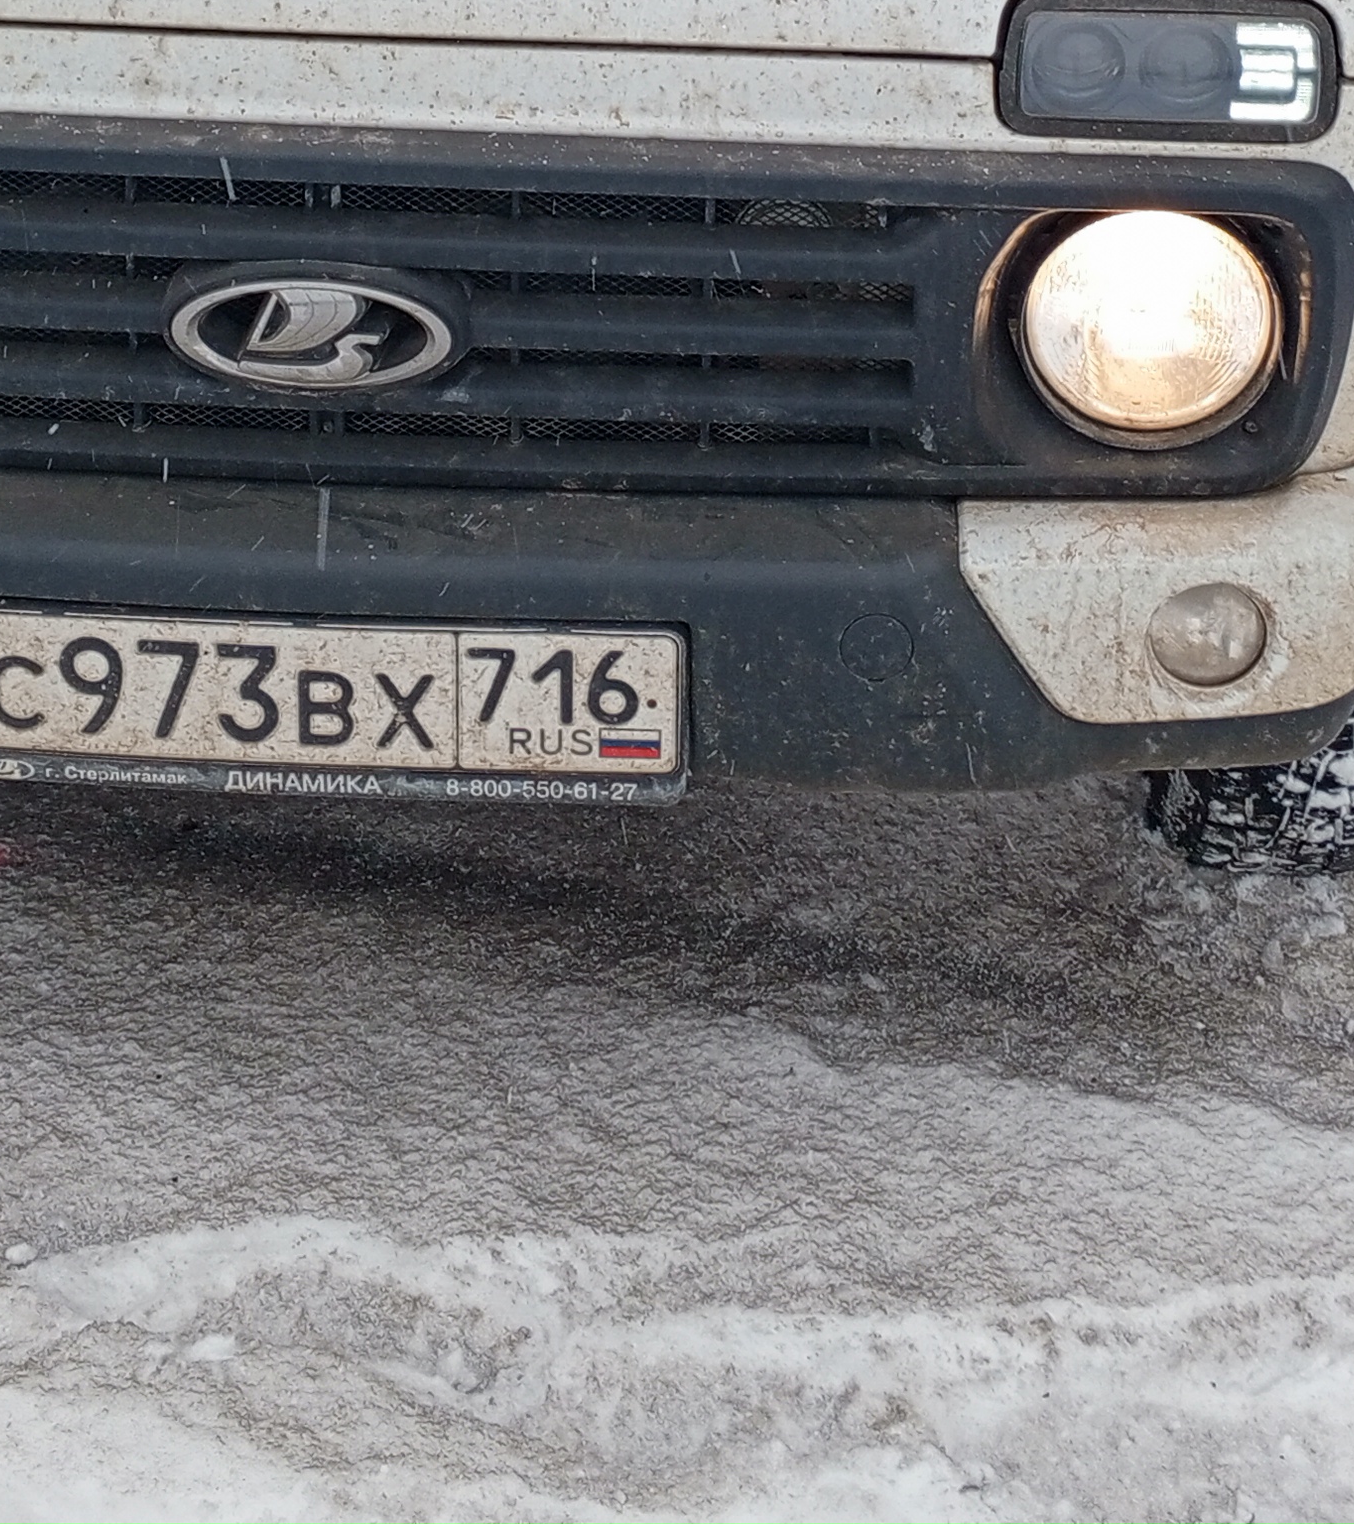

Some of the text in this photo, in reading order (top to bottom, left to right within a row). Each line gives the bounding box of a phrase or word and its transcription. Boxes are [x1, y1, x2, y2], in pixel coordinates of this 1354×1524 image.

[467, 647, 641, 725] 716
[508, 727, 594, 756] RUS
[64, 766, 188, 786] Стерлитамак
[224, 770, 383, 797] ДИНАМИКА
[445, 777, 638, 802] 8-800-550-61-27
